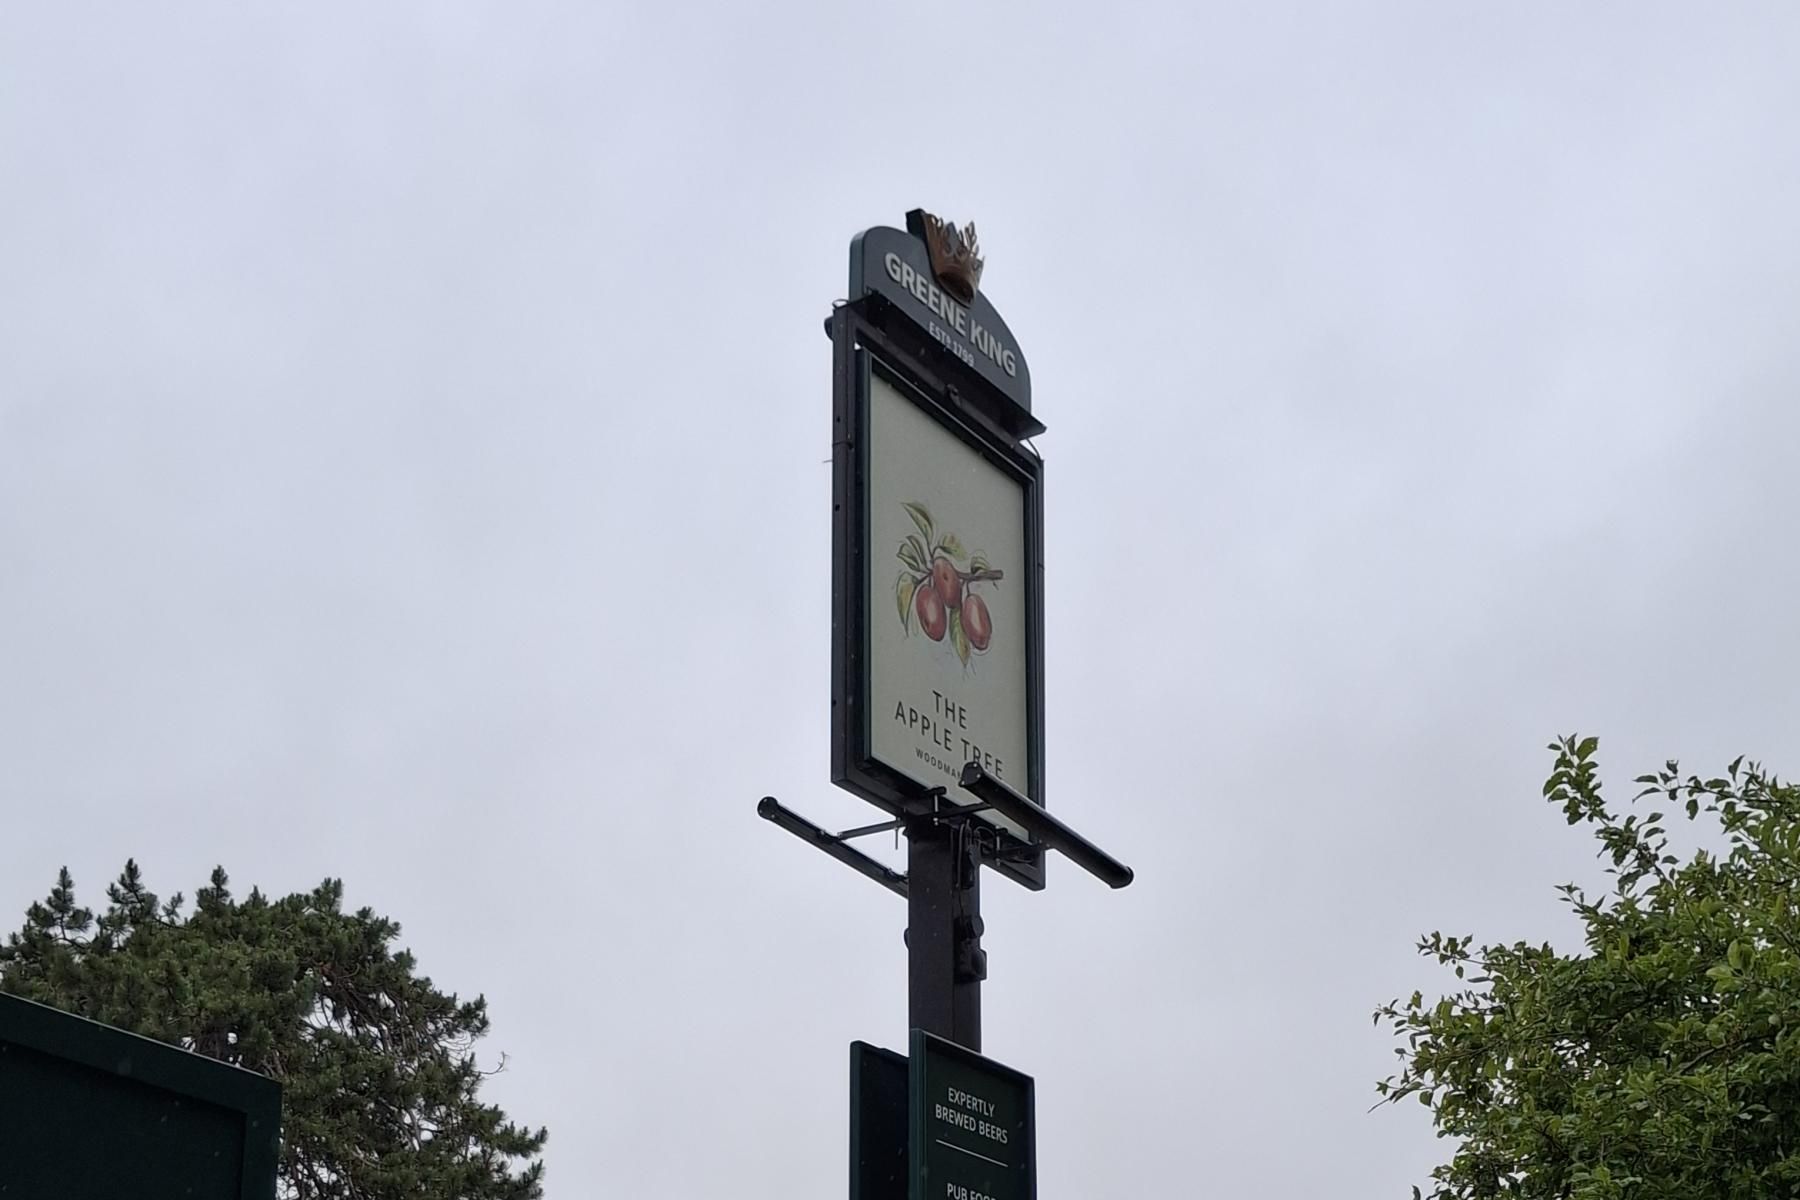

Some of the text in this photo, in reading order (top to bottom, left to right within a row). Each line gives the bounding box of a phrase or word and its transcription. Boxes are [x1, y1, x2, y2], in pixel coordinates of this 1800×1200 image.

[885, 252, 1017, 378] GREENE KING
[894, 700, 953, 752] APPLE
[933, 690, 967, 729] THE
[948, 1087, 995, 1117] EXPERTLY
[935, 1103, 1008, 1144] BREWED BEERS
